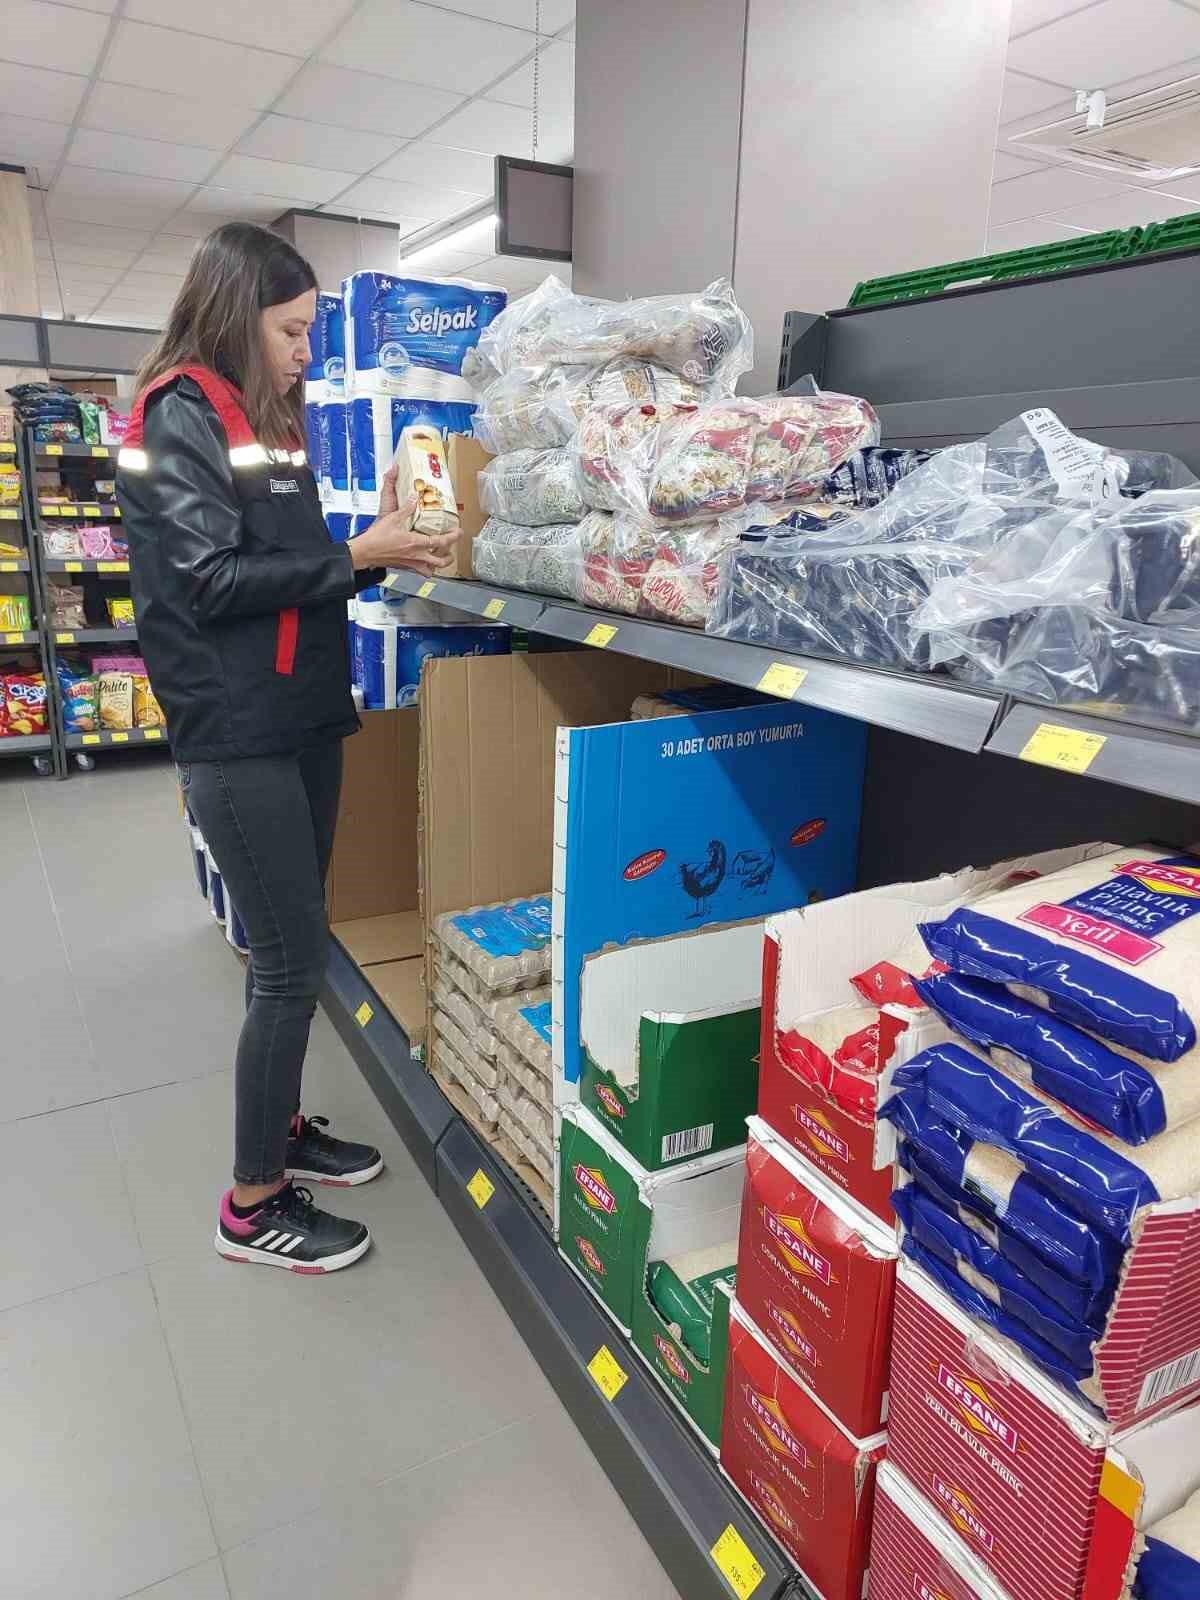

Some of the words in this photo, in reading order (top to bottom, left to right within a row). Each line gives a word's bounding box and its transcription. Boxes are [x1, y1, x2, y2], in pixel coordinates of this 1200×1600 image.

[380, 280, 391, 289] 24
[326, 302, 337, 310] 24
[405, 305, 478, 337] Selpak
[394, 404, 405, 412] 24
[400, 631, 410, 639] 24
[661, 742, 674, 758] 30
[676, 738, 704, 755] ADET
[707, 734, 734, 751] ORTA
[737, 730, 756, 747] BOY
[759, 724, 804, 743] YUMURTA
[1131, 865, 1200, 890] EFSA
[1089, 893, 1164, 923] Pirinç
[1099, 882, 1192, 915] Pilavlık
[1059, 914, 1121, 943] Yerli
[800, 1112, 843, 1155] EFSANE
[580, 1169, 610, 1206] EFSANE
[769, 1218, 824, 1274] EFSANE
[773, 1310, 812, 1357] EFSANE
[946, 1375, 1008, 1440] EFSANE
[752, 1395, 800, 1458] EFSANE
[938, 1482, 988, 1541] EFSANE
